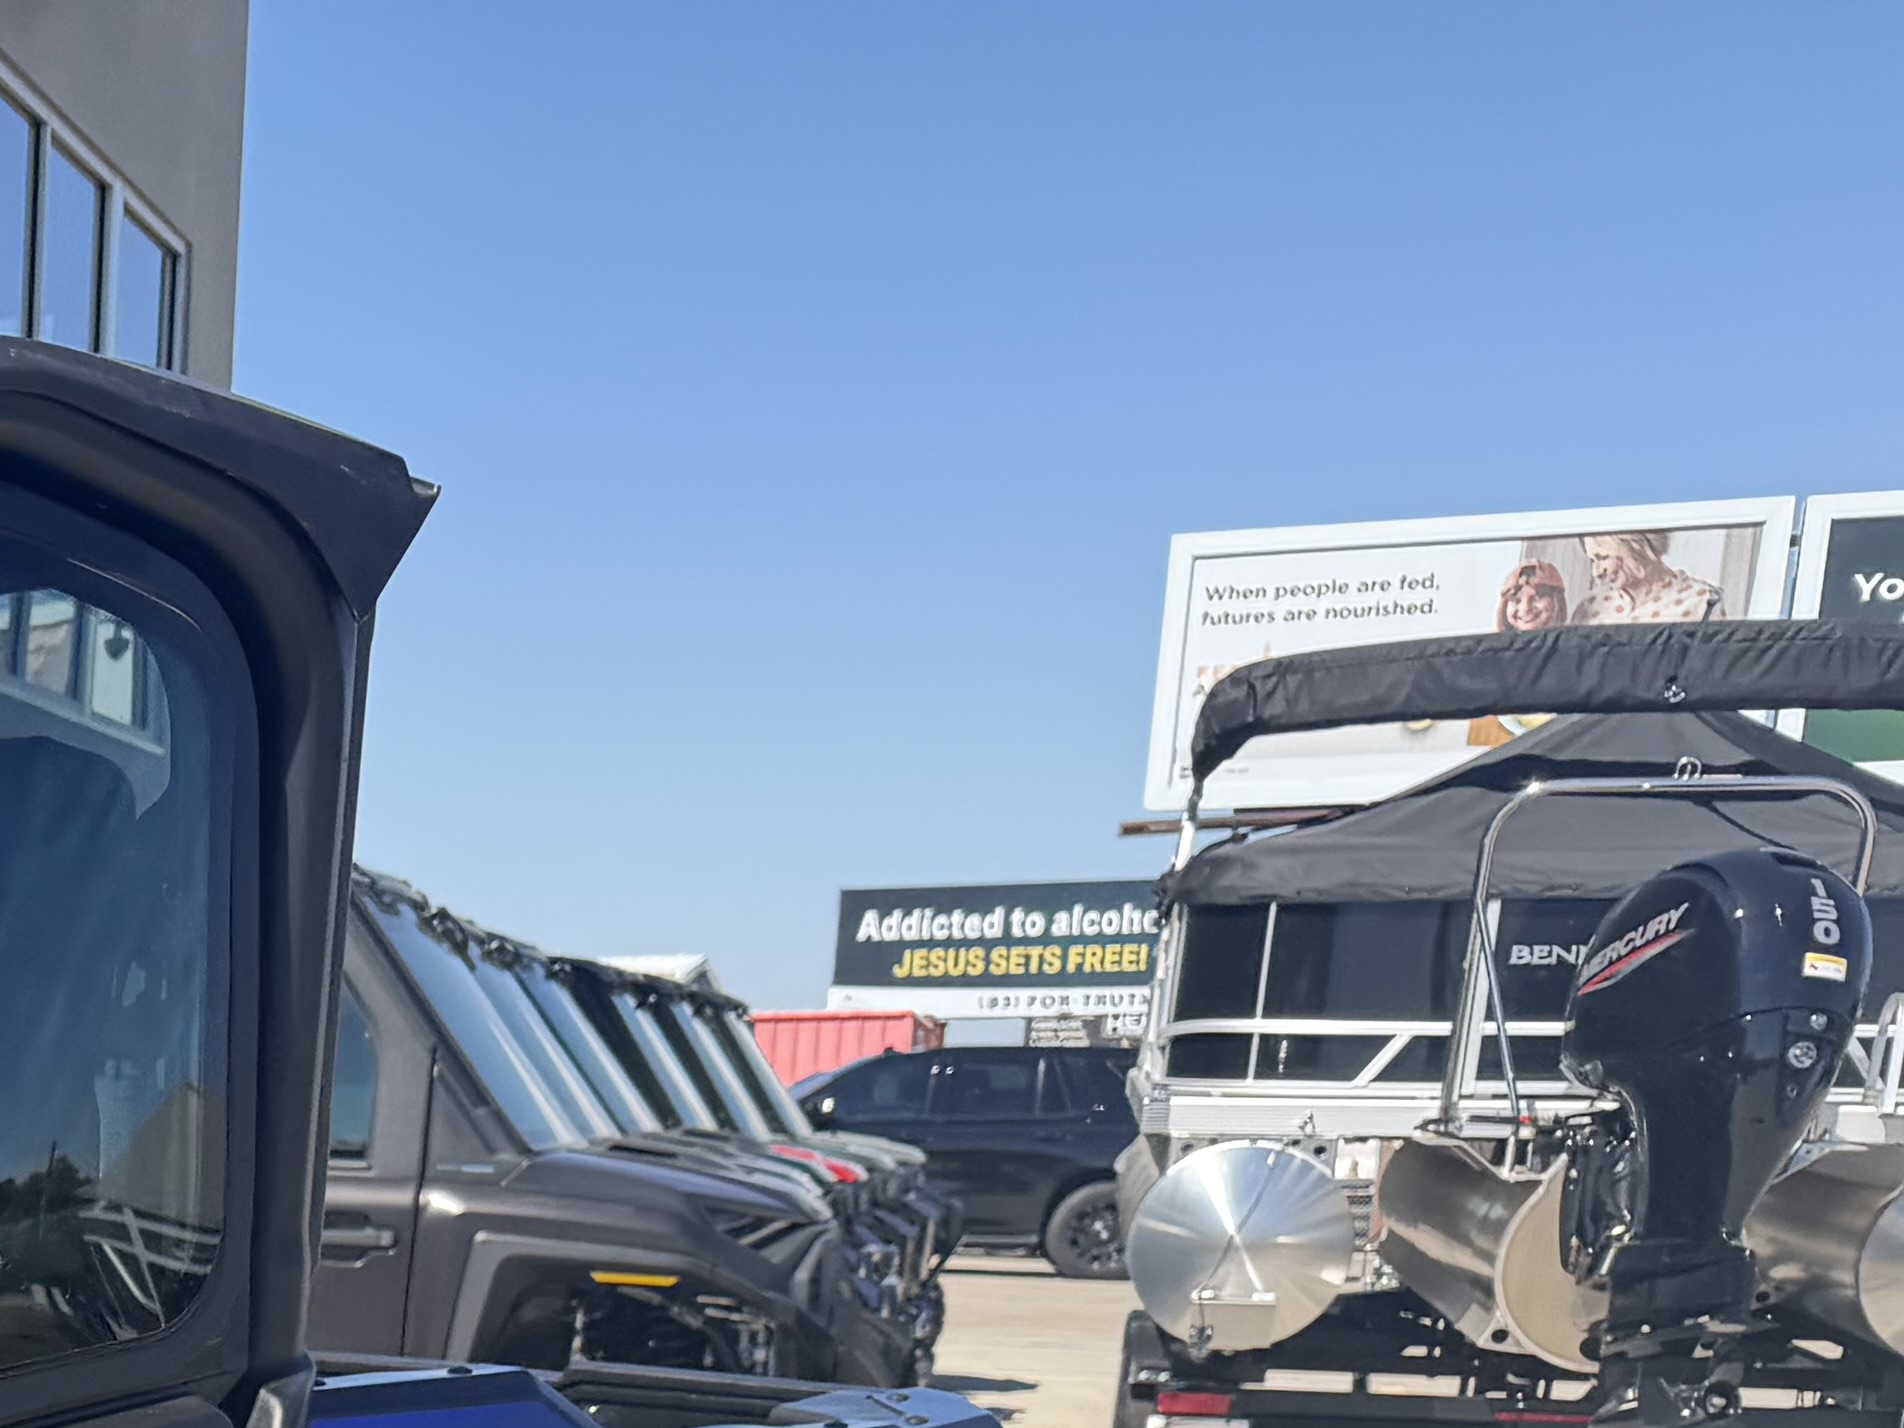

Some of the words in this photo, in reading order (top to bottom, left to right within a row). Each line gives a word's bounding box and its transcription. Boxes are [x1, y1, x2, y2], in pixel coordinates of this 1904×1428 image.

[1205, 585, 1267, 601] When
[1274, 579, 1350, 601] people
[1356, 580, 1392, 593] are
[1398, 572, 1440, 591] fed,
[1200, 609, 1276, 626] futures
[1282, 608, 1318, 622] are
[1324, 598, 1438, 621] nourished.
[855, 905, 1005, 943] Addicted
[1010, 905, 1046, 938] to
[1810, 876, 1842, 946] 150
[893, 947, 986, 979] JESUS
[989, 945, 1063, 976] SETS
[1066, 943, 1150, 974] FREE!
